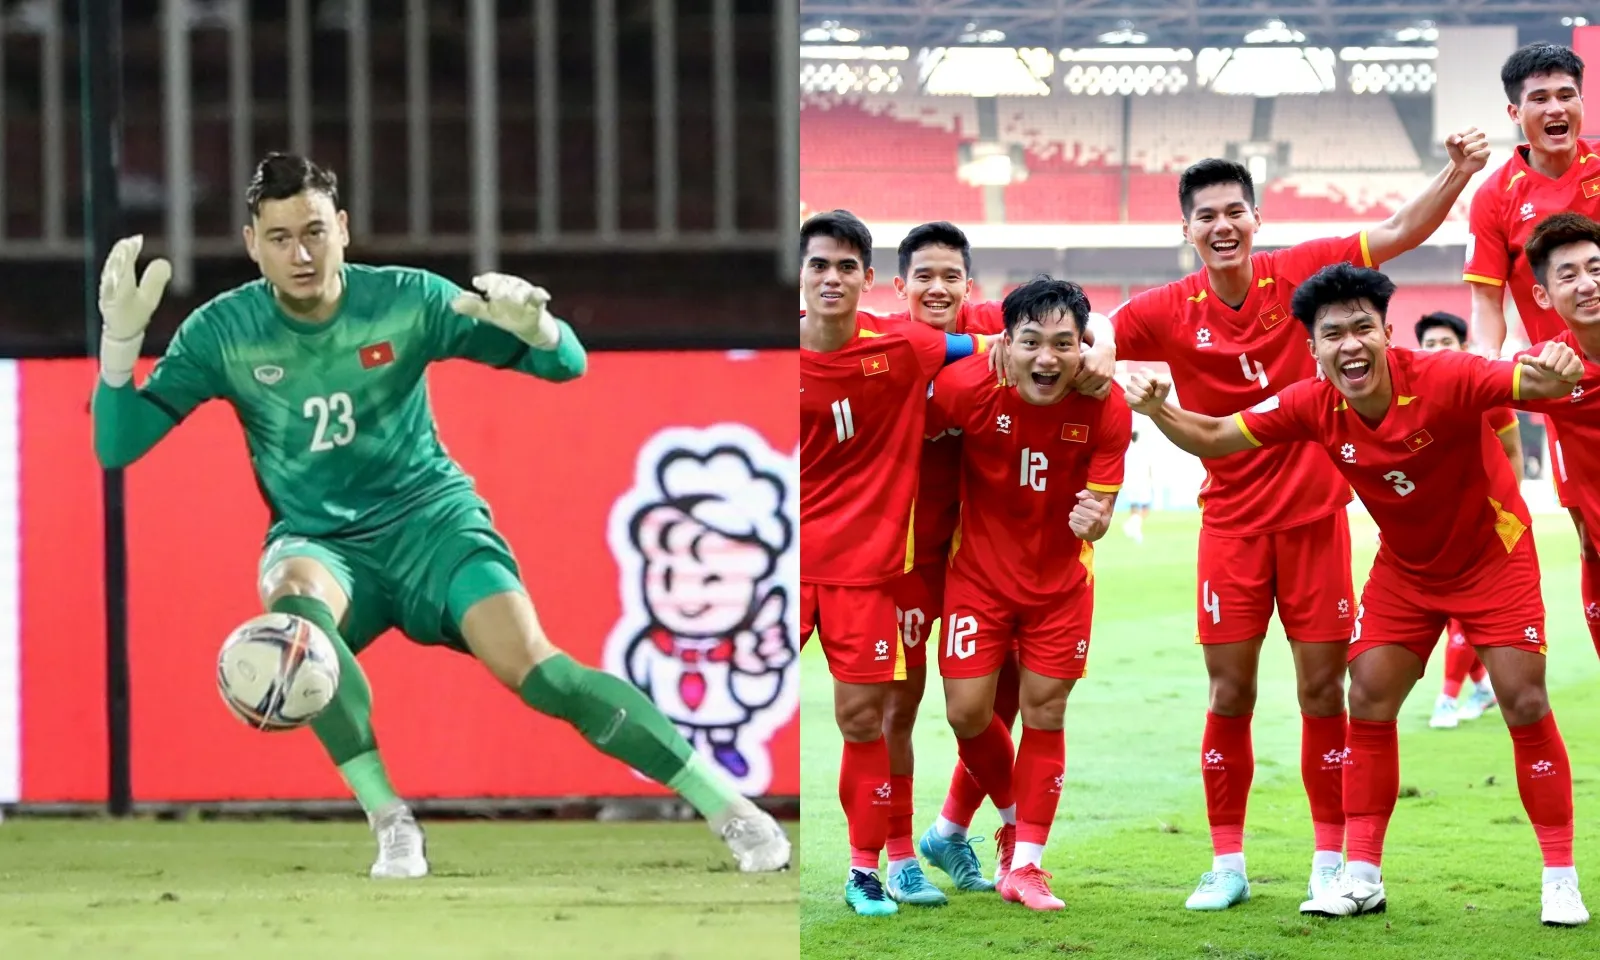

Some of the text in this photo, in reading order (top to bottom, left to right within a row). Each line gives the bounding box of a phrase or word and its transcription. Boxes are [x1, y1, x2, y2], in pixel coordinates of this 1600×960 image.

[1238, 352, 1269, 389] 4
[303, 391, 356, 452] 23
[831, 397, 855, 443] 11
[1019, 447, 1049, 492] 12
[1382, 470, 1416, 497] 3
[1203, 580, 1221, 625] 4
[946, 613, 978, 660] 12
